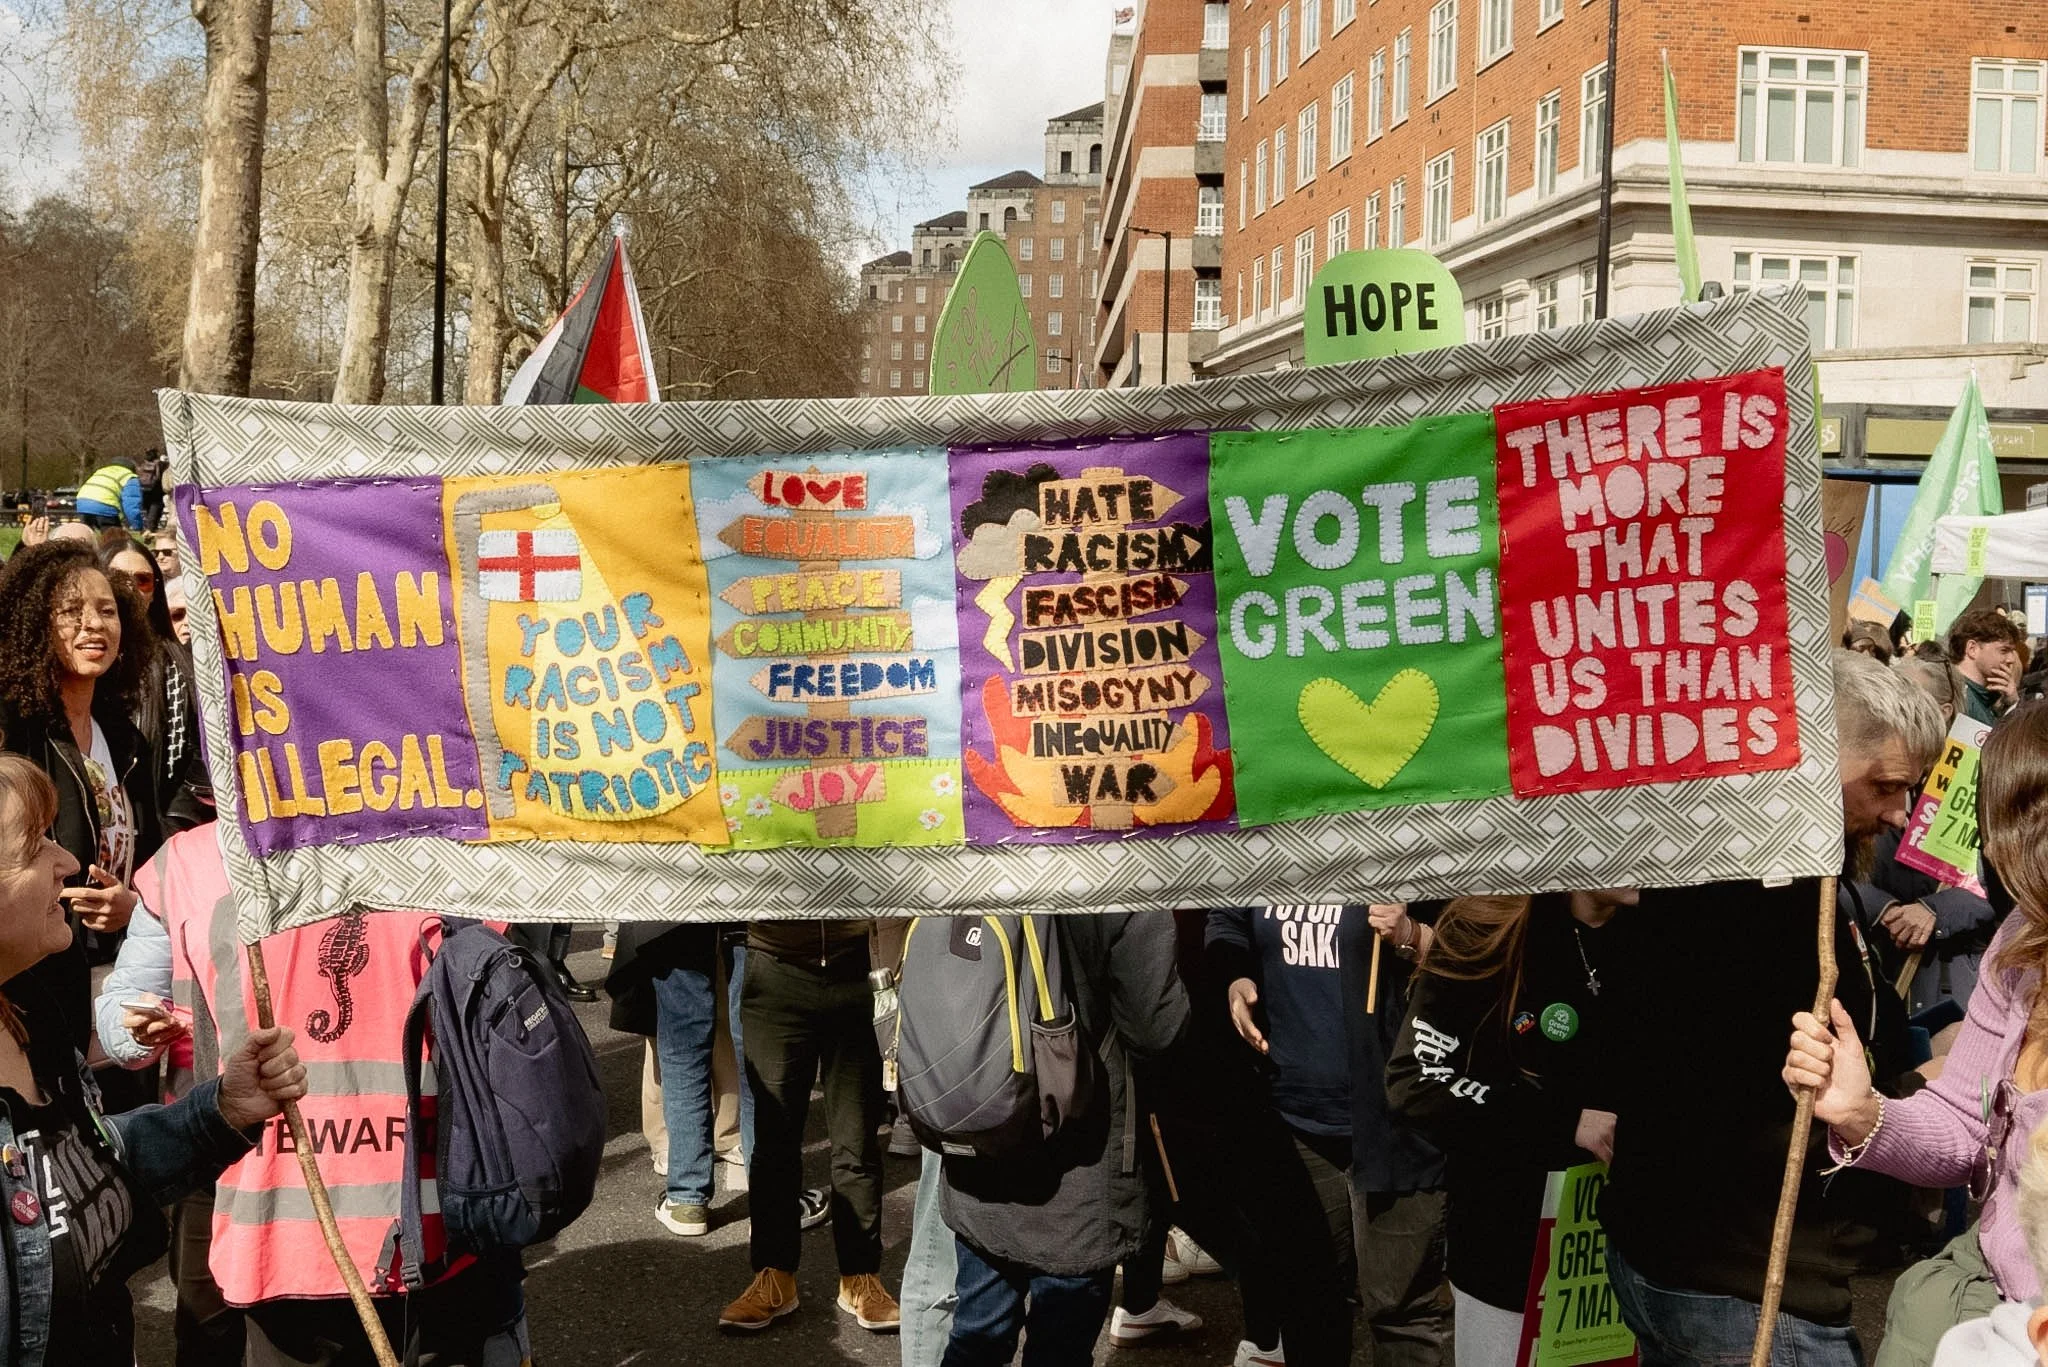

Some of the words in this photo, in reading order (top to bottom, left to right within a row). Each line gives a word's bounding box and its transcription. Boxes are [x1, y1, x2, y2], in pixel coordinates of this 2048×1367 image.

[1323, 282, 1438, 337] HOPE
[1505, 396, 1702, 488] THERE
[1722, 392, 1777, 450] IS
[1045, 480, 1155, 525] HATE
[1558, 456, 1726, 531] MORE
[195, 500, 292, 576] NO
[743, 517, 914, 556] EQUALITY
[1024, 529, 1191, 574] RACISM
[1224, 476, 1481, 577] VOTE
[1565, 517, 1714, 588] THAT
[212, 571, 444, 661] HUMAN
[750, 571, 884, 613] PEACE
[1026, 575, 1182, 626] FASCISM
[1230, 567, 1495, 659] GREEN
[517, 592, 664, 657] YOUR
[733, 615, 912, 655] COMMUNITY
[1531, 580, 1760, 659] UNITES
[1022, 621, 1189, 671] DIVISION
[504, 635, 693, 710] RACISM
[768, 658, 936, 697] FREEDOM
[1016, 669, 1197, 712] MISOGYNY
[1531, 656, 1608, 716] US
[1631, 644, 1773, 707] THAN
[231, 670, 290, 736] IS
[536, 718, 580, 760] IS
[592, 683, 701, 756] NOT
[749, 716, 927, 758] JUSTICE
[1033, 718, 1176, 758] INEQUALITY
[1532, 706, 1779, 777] DIVIDES
[237, 734, 484, 823] ILLEGAL.
[496, 742, 711, 814] PATRIOTIC
[788, 763, 876, 810] JOY
[1061, 763, 1158, 804] WAR
[1281, 920, 1340, 969] SAK
[1548, 1026, 1568, 1039] Party
[1549, 1019, 1570, 1032] Green
[256, 1117, 406, 1157] TEWAR
[1556, 1288, 1573, 1333] 7
